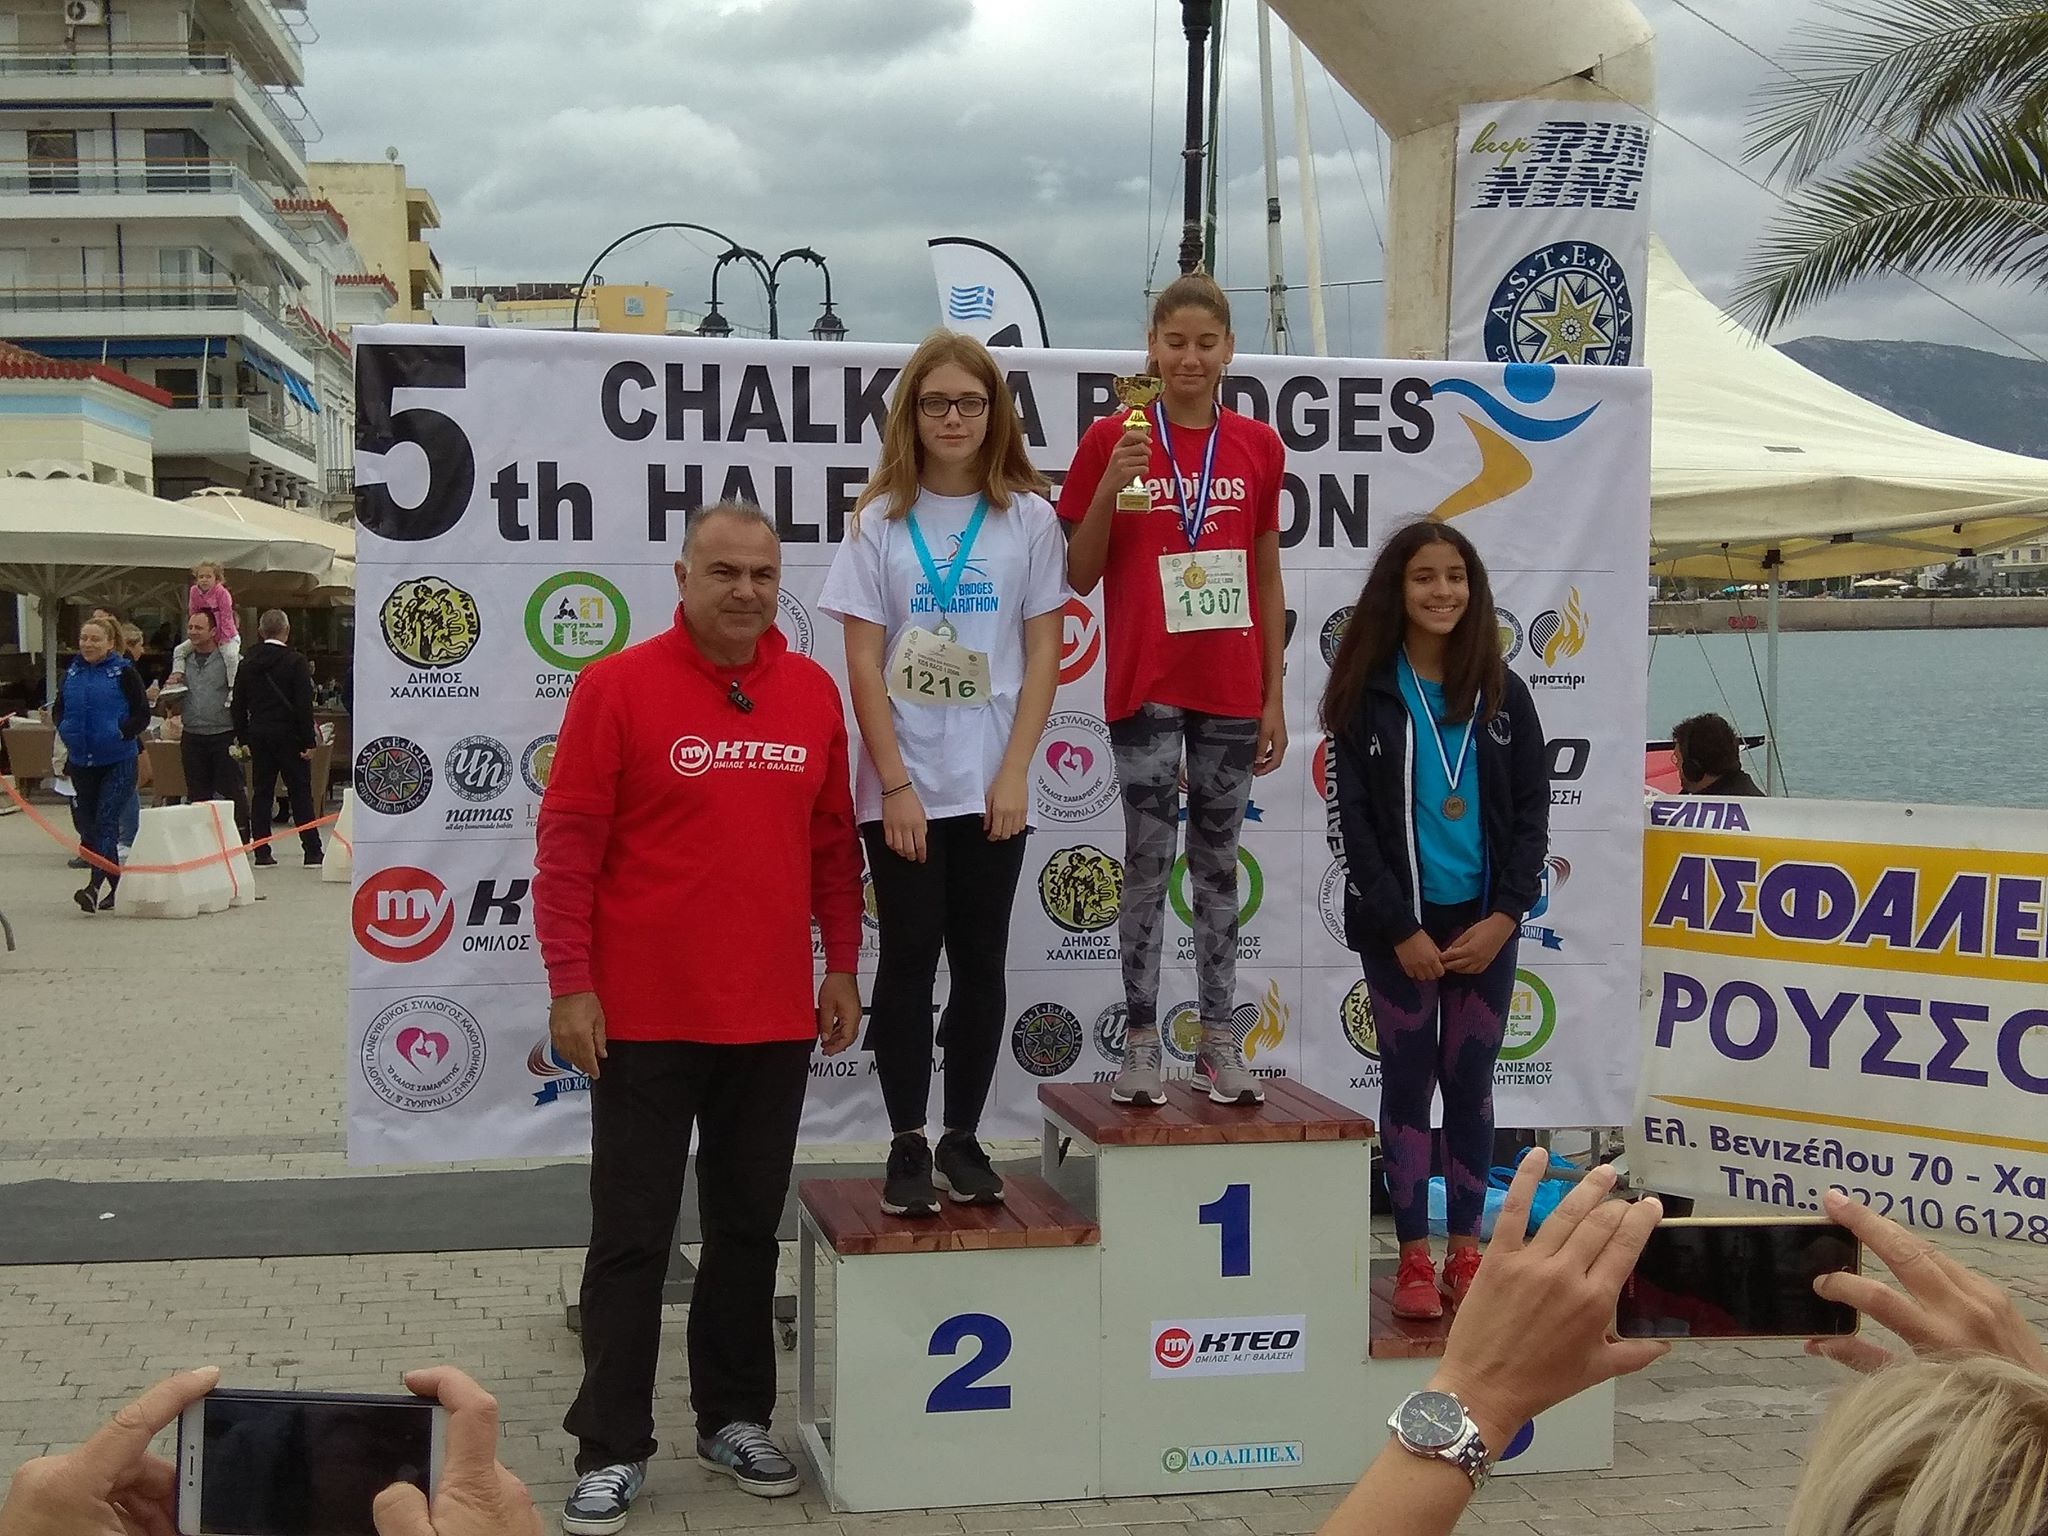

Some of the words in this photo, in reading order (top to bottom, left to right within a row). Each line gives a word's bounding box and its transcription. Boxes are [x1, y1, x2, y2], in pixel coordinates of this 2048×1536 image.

[959, 582, 993, 596] BRIDGES
[910, 598, 937, 613] HALF
[1178, 587, 1241, 617] 1007
[407, 672, 463, 684] ΔΗΜΟΣ
[902, 665, 977, 699] 1216
[1529, 673, 1585, 690] ψηστήρι
[390, 686, 480, 698] ΧΑΛΚΙΔΕΩΝ
[445, 806, 514, 823] namas
[1650, 801, 1750, 832] ΕΛΠΑ
[1650, 854, 2048, 960] ΑΣΦΑΛΕ
[462, 934, 531, 952] ΟΜΙΛΟΣ
[1061, 935, 1111, 947] ΔΗΜΟΣ
[808, 1061, 858, 1077] ΜΙΛΟΣ
[1644, 1115, 1697, 1149] Ελ.
[1709, 1124, 1894, 1178] Βενιζέλου
[1907, 1151, 1954, 1187] 70
[1199, 1184, 1251, 1278] 1
[926, 1313, 1012, 1414] 2
[1195, 1354, 1230, 1364] ΟΜΙΛΟΣ
[1252, 1351, 1294, 1361] ΘΑΛΑΣΣΗ
